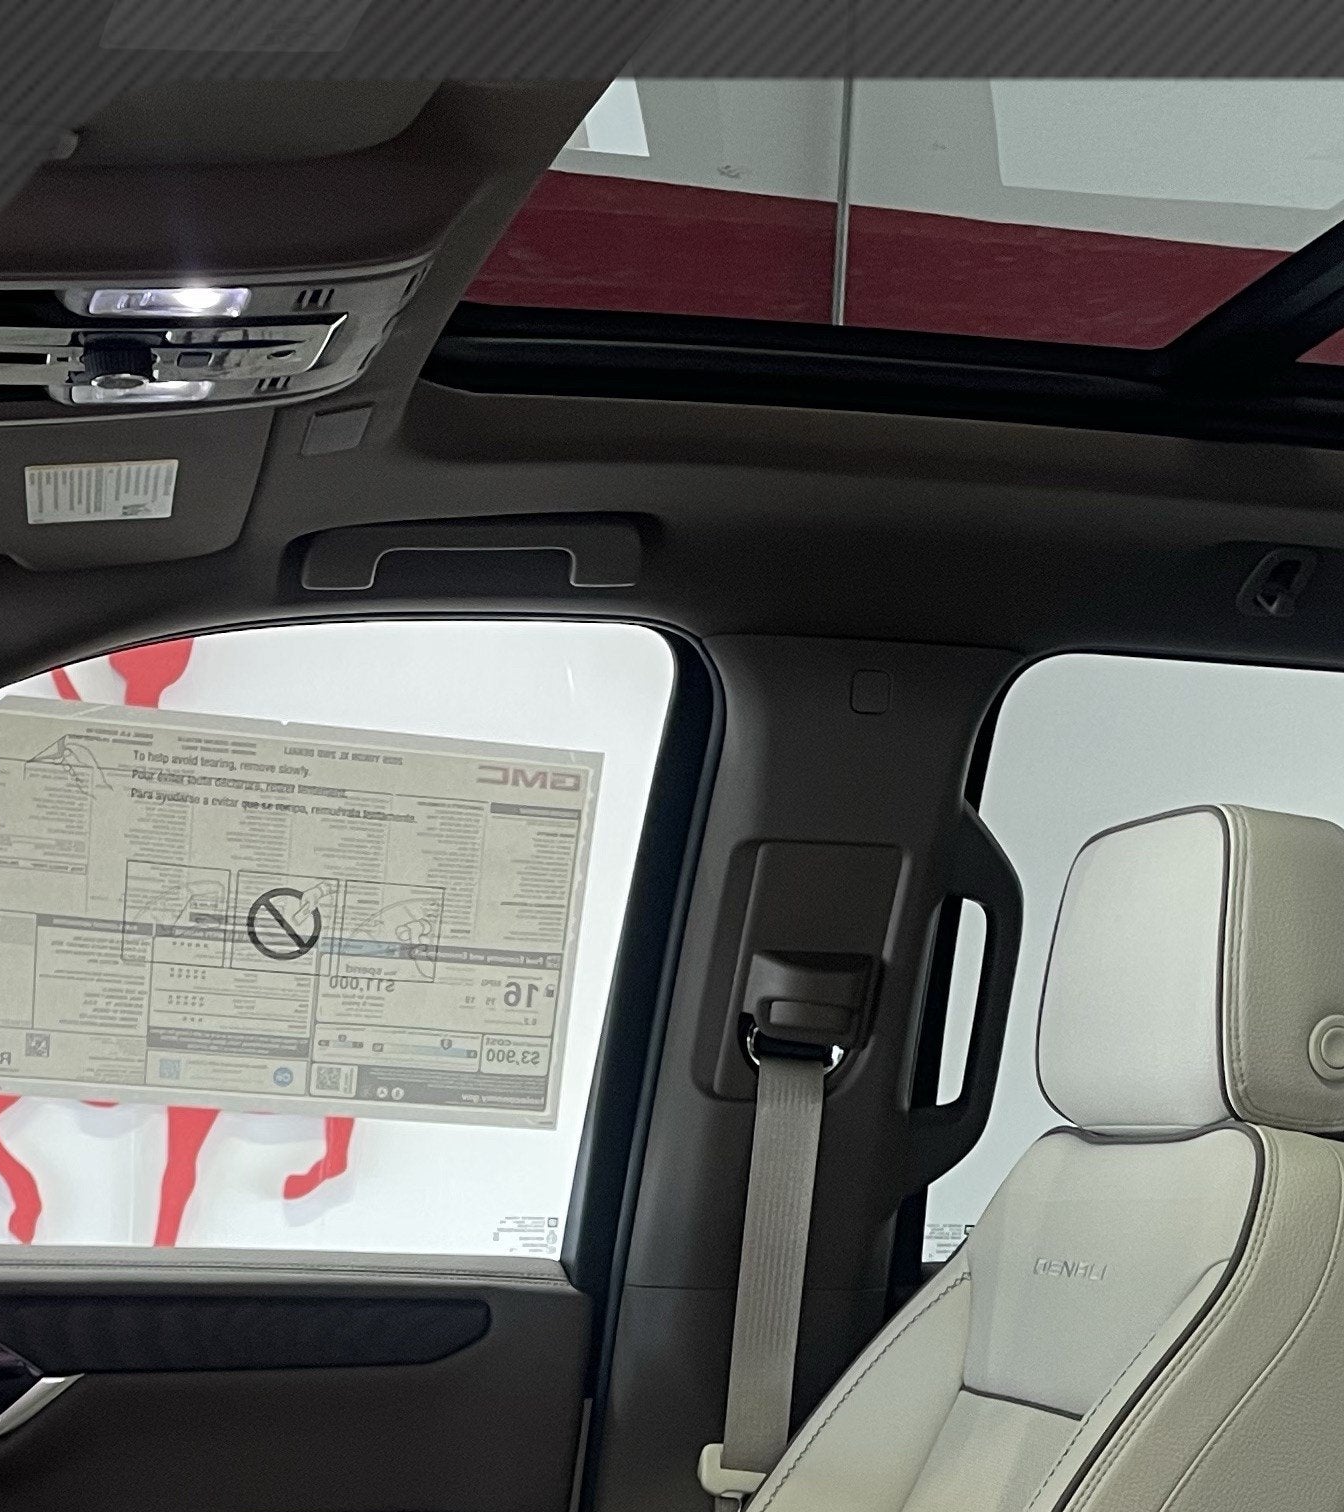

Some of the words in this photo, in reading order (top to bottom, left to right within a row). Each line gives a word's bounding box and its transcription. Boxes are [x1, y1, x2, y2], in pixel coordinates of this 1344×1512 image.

[134, 750, 145, 761] To
[148, 752, 169, 764] help
[171, 755, 198, 766] avoid
[200, 757, 237, 771] tearing,
[240, 762, 276, 773] remove
[1033, 1256, 1108, 1282] DENALI
